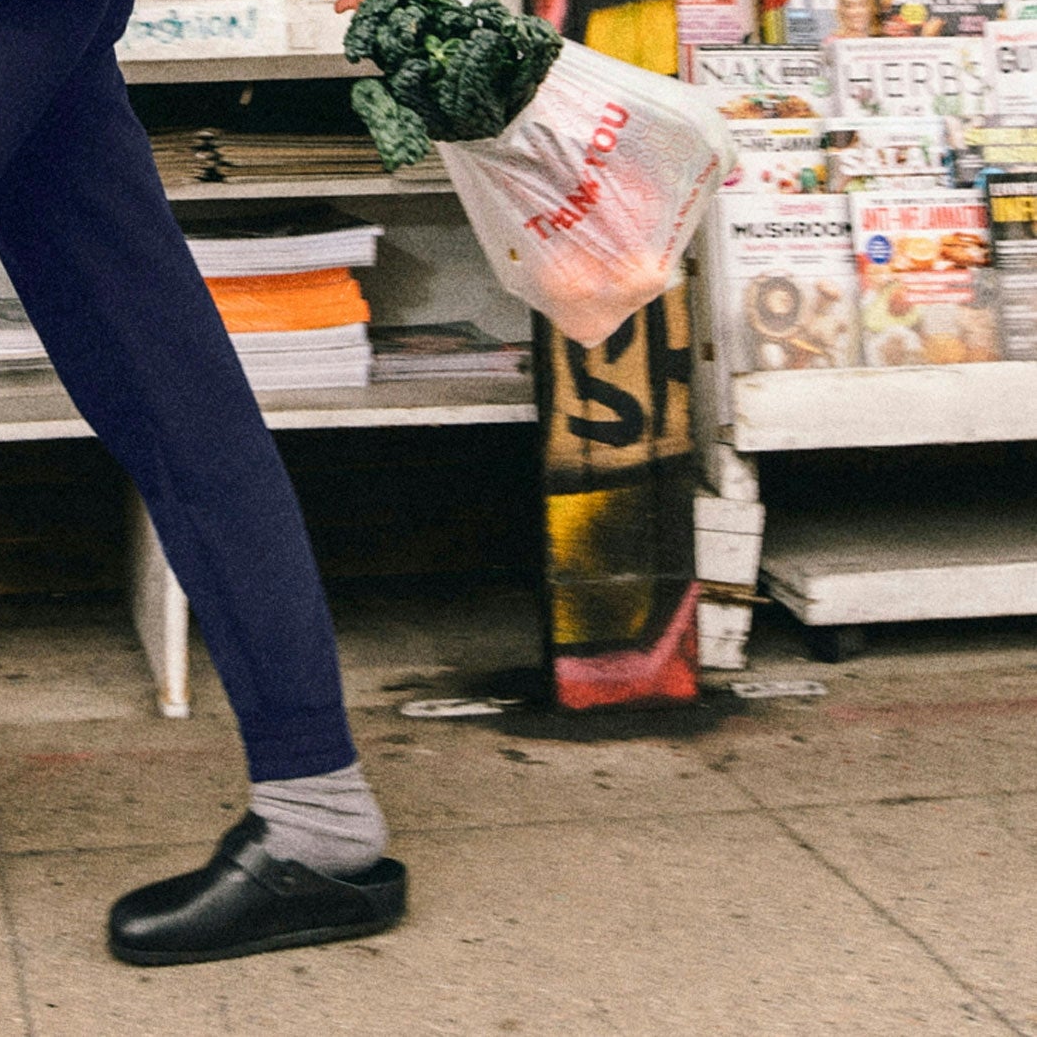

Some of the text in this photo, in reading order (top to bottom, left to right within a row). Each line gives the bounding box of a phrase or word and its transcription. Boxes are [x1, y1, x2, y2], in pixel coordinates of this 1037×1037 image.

[846, 62, 987, 97] HERBS
[584, 101, 631, 169] YOU
[523, 168, 601, 241] THANK
